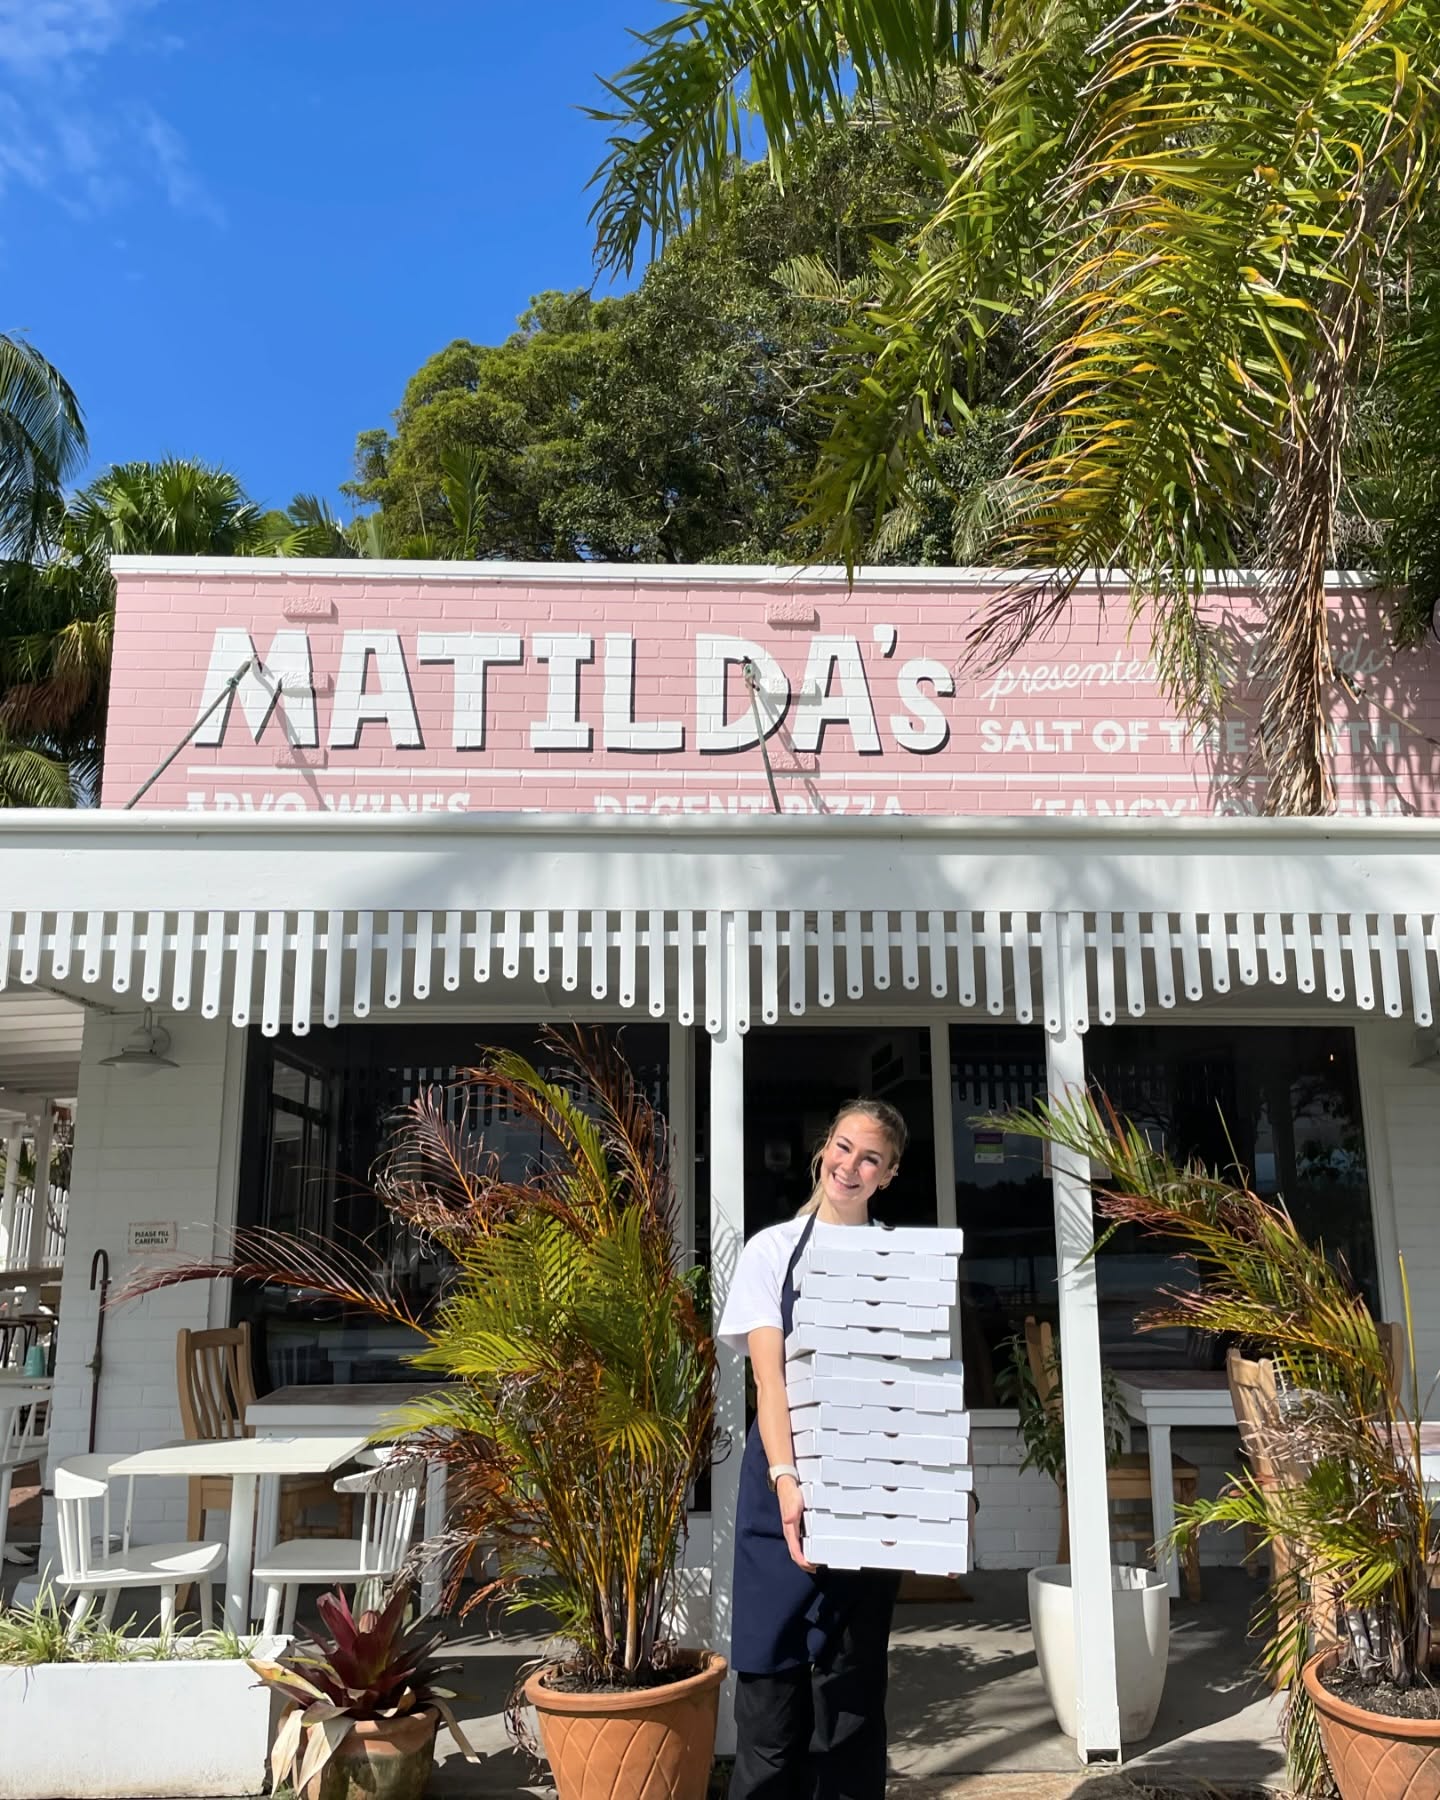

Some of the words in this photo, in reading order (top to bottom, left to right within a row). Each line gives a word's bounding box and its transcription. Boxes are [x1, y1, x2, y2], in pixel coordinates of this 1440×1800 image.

[980, 719, 1081, 753] SALT
[1092, 719, 1149, 753] OF
[135, 1230, 157, 1238] PLEASE
